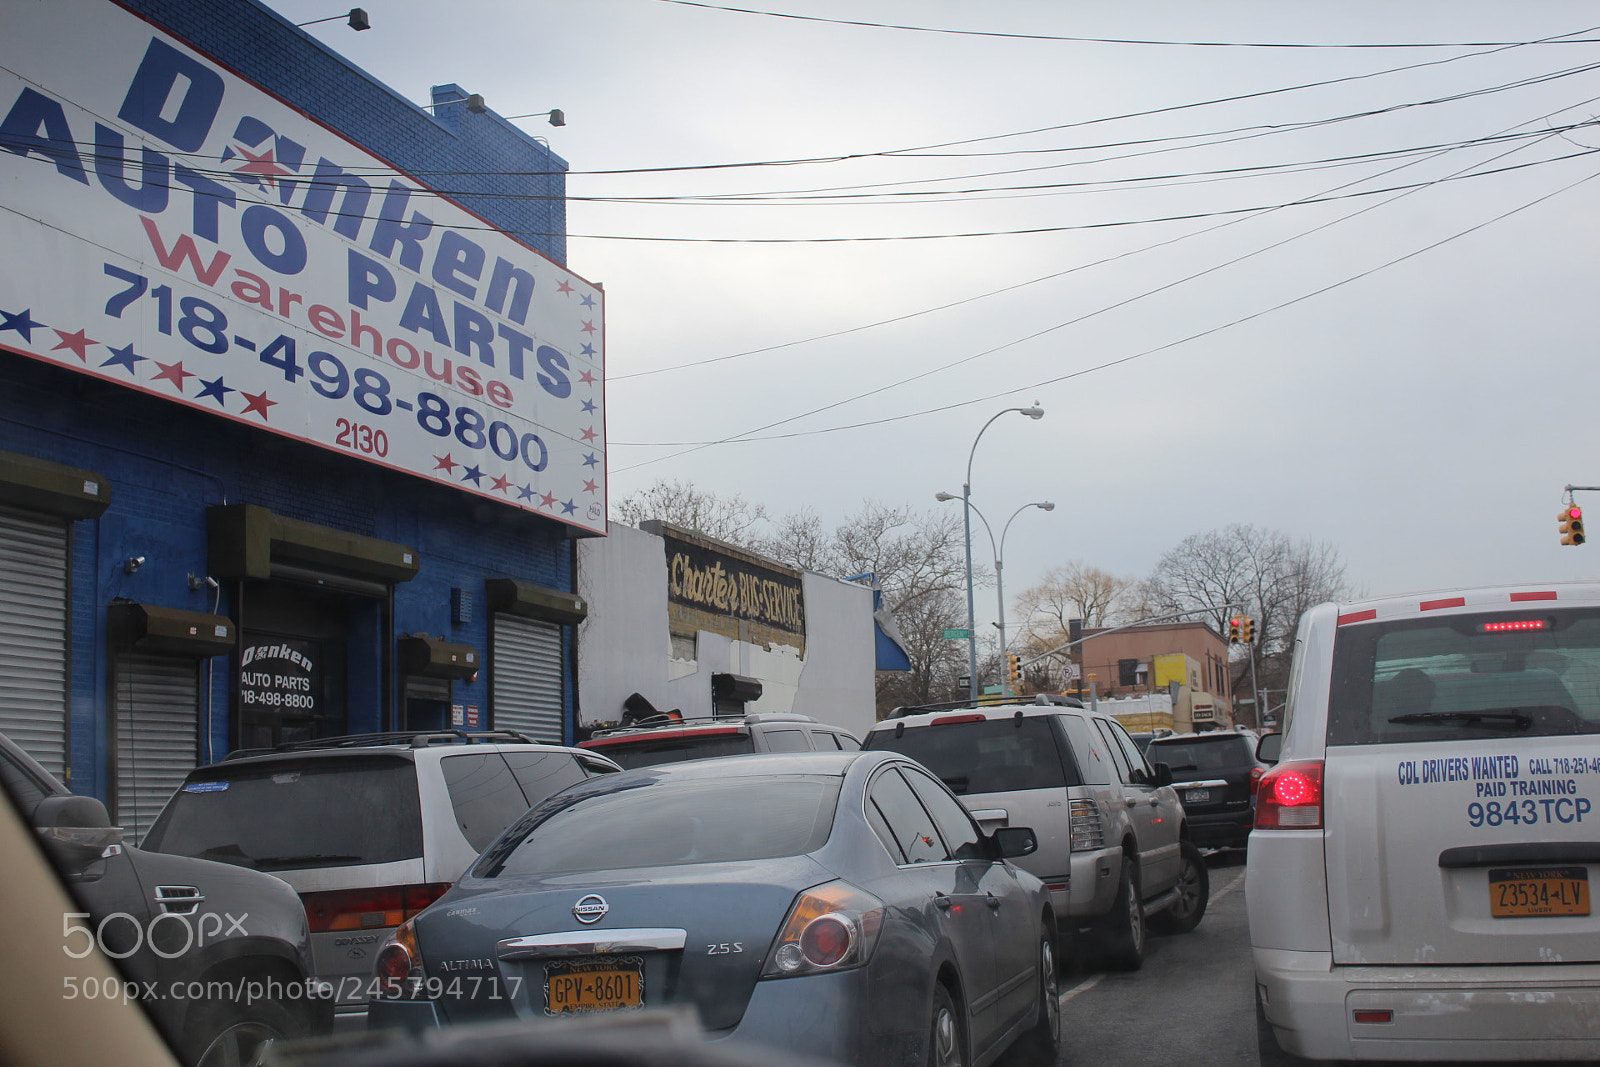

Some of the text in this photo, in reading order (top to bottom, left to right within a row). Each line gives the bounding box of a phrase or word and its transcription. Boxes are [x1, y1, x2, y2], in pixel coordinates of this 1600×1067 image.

[0, 86, 573, 399] AUTO PARTS
[138, 214, 514, 409] Warehouse
[103, 262, 549, 473] 718-498-8800
[335, 418, 389, 458] 2130
[739, 571, 761, 618] BUS
[762, 579, 802, 628] SERVICE
[241, 671, 310, 691] AUTO PARTS
[1399, 761, 1420, 785] CDL
[1422, 757, 1468, 783] DRIVERS
[1471, 755, 1519, 780] WANTED
[1529, 758, 1552, 775] CALL
[1476, 779, 1577, 798] PAID TRAINING
[335, 935, 380, 946] ODYSSEY
[440, 958, 494, 972] ALTIMA
[569, 963, 619, 973] NEW YORK
[569, 1003, 596, 1011] EMPIRE
